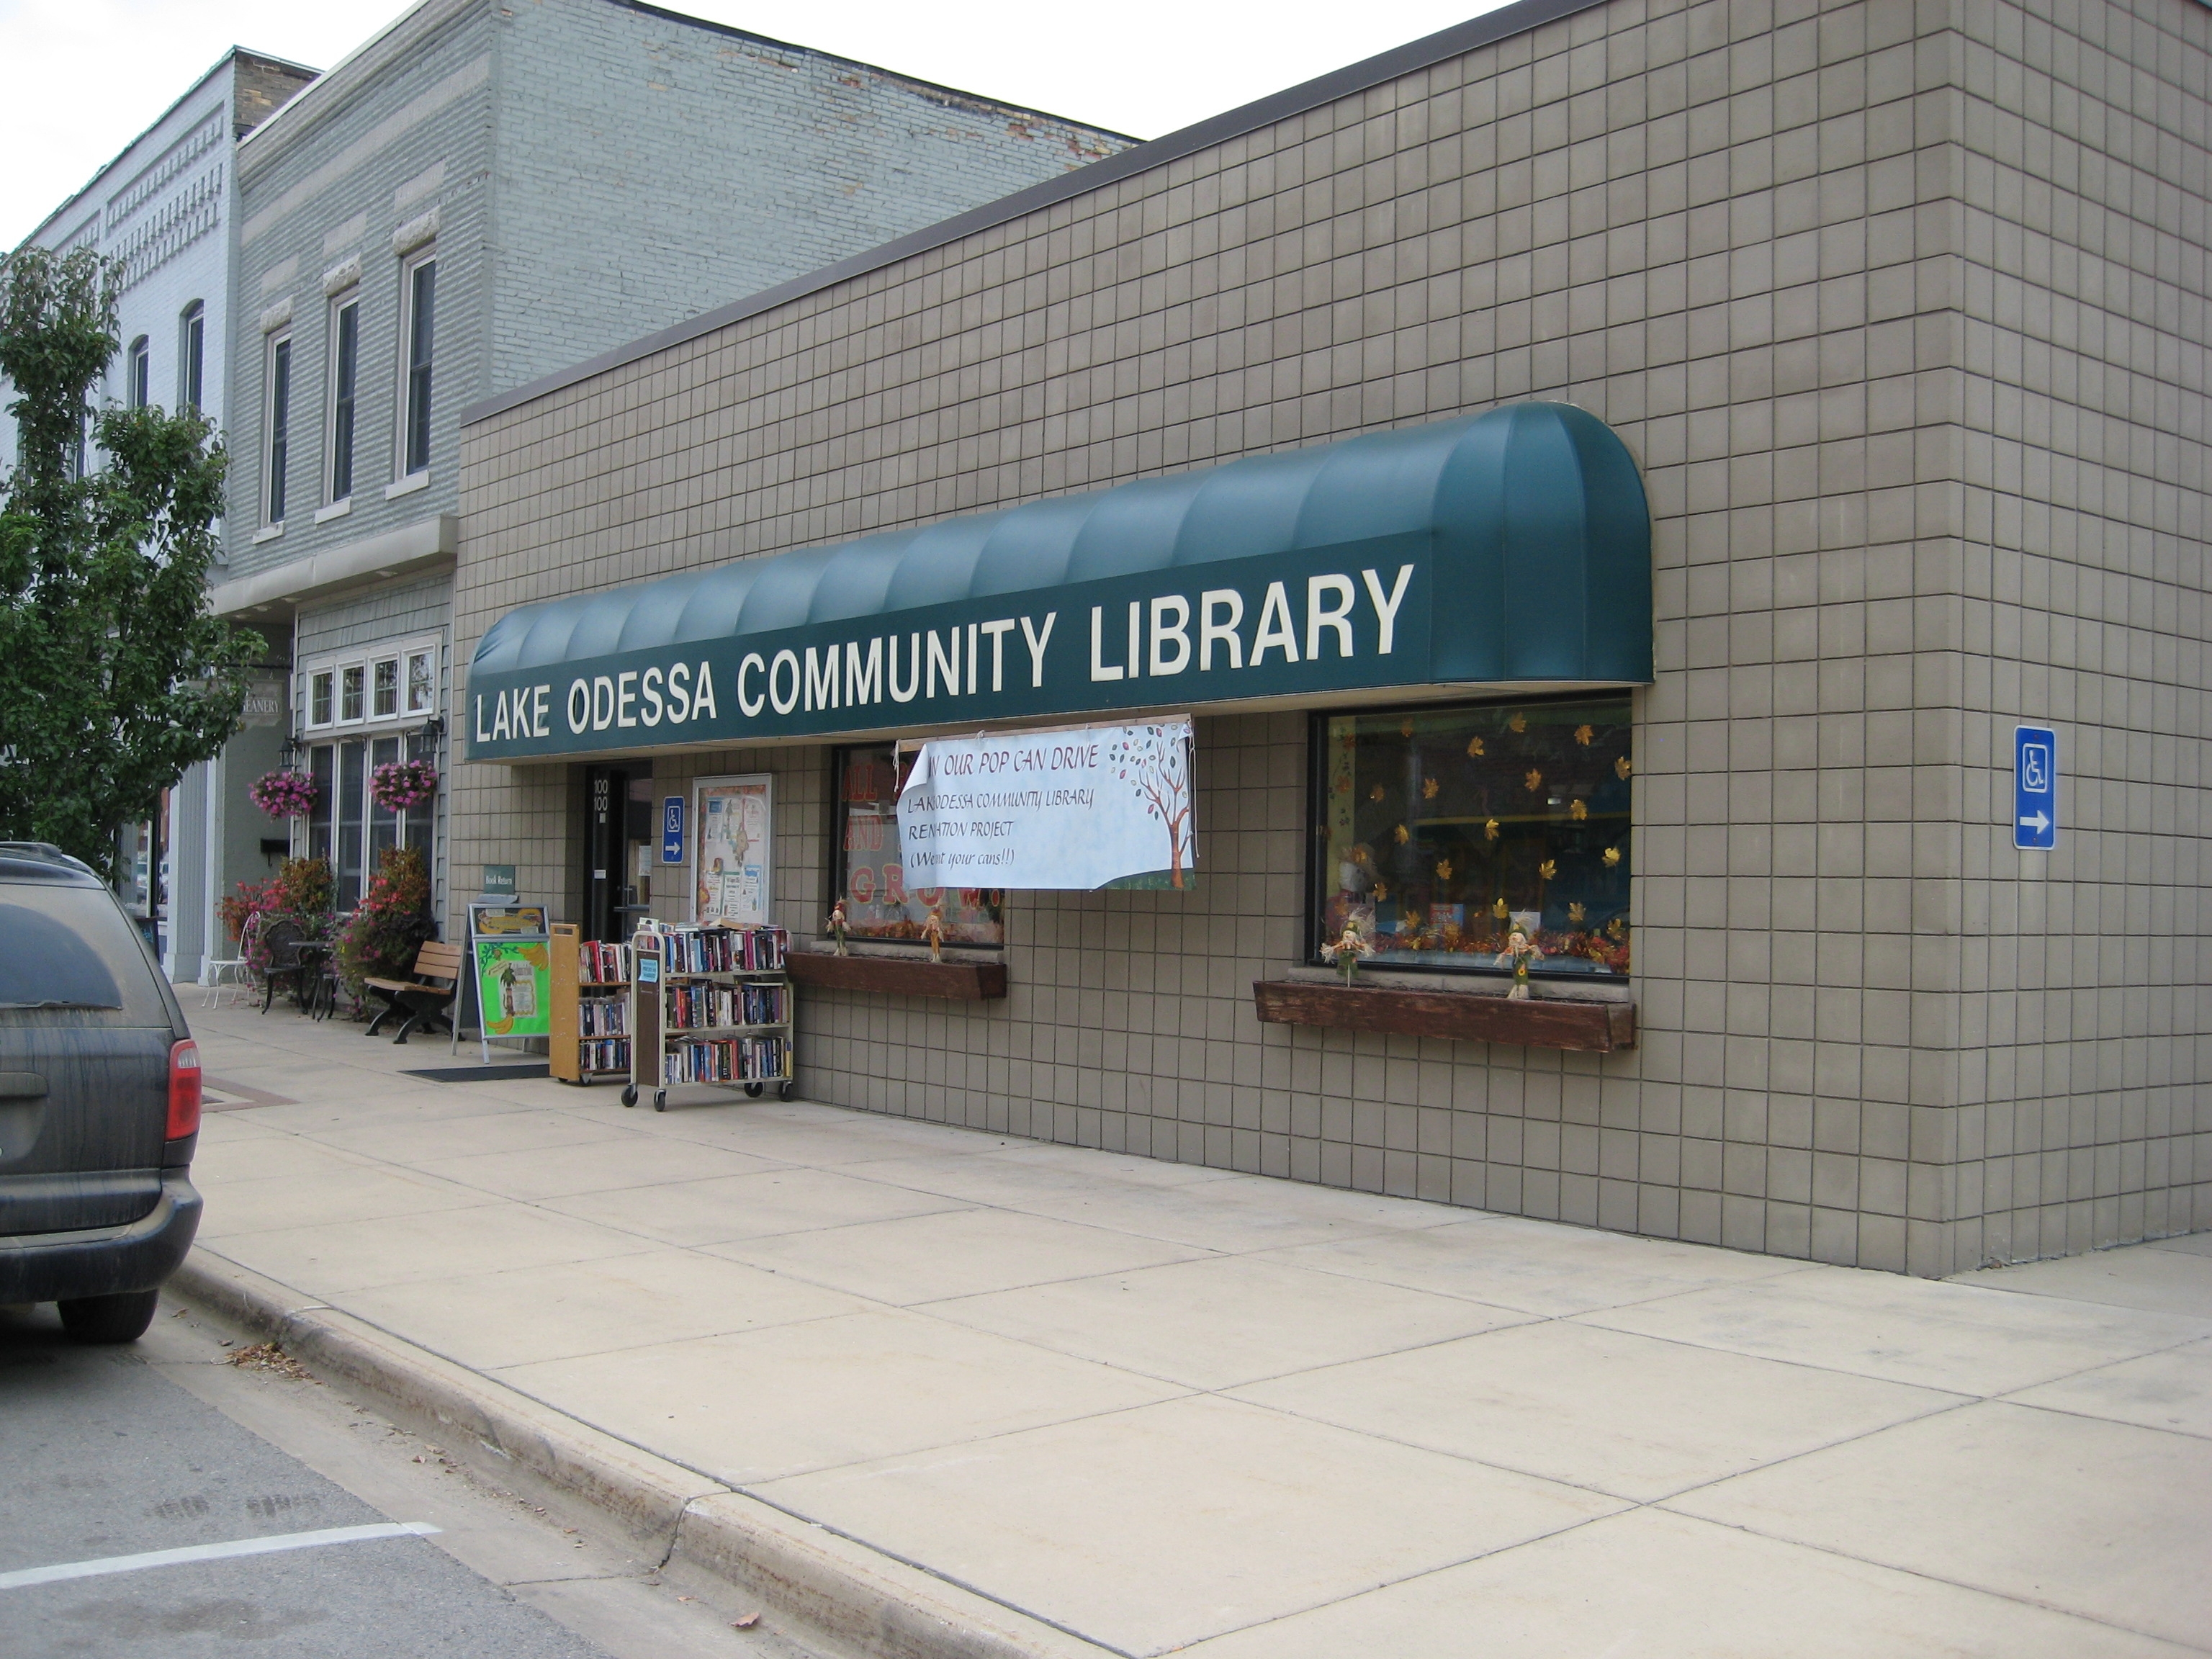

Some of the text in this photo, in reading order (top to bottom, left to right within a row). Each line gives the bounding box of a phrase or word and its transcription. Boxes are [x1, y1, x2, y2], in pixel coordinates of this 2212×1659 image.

[476, 564, 1414, 742] LAKE ODESSA COMMUNITY LIBRARY
[944, 754, 974, 775] OUR
[979, 751, 1010, 775] POP
[1013, 748, 1047, 773] CAN
[1051, 744, 1100, 770] DRIVE
[593, 779, 608, 794] 100
[841, 763, 878, 801] ALL
[593, 796, 608, 811] 100
[976, 791, 1043, 812] COMMUNITY
[1046, 788, 1094, 810] LIBRARY
[843, 814, 884, 852] AND
[969, 821, 1014, 840] PROJECT
[948, 853, 976, 871] your
[977, 848, 1015, 866] cans!!)
[485, 875, 497, 885] Book
